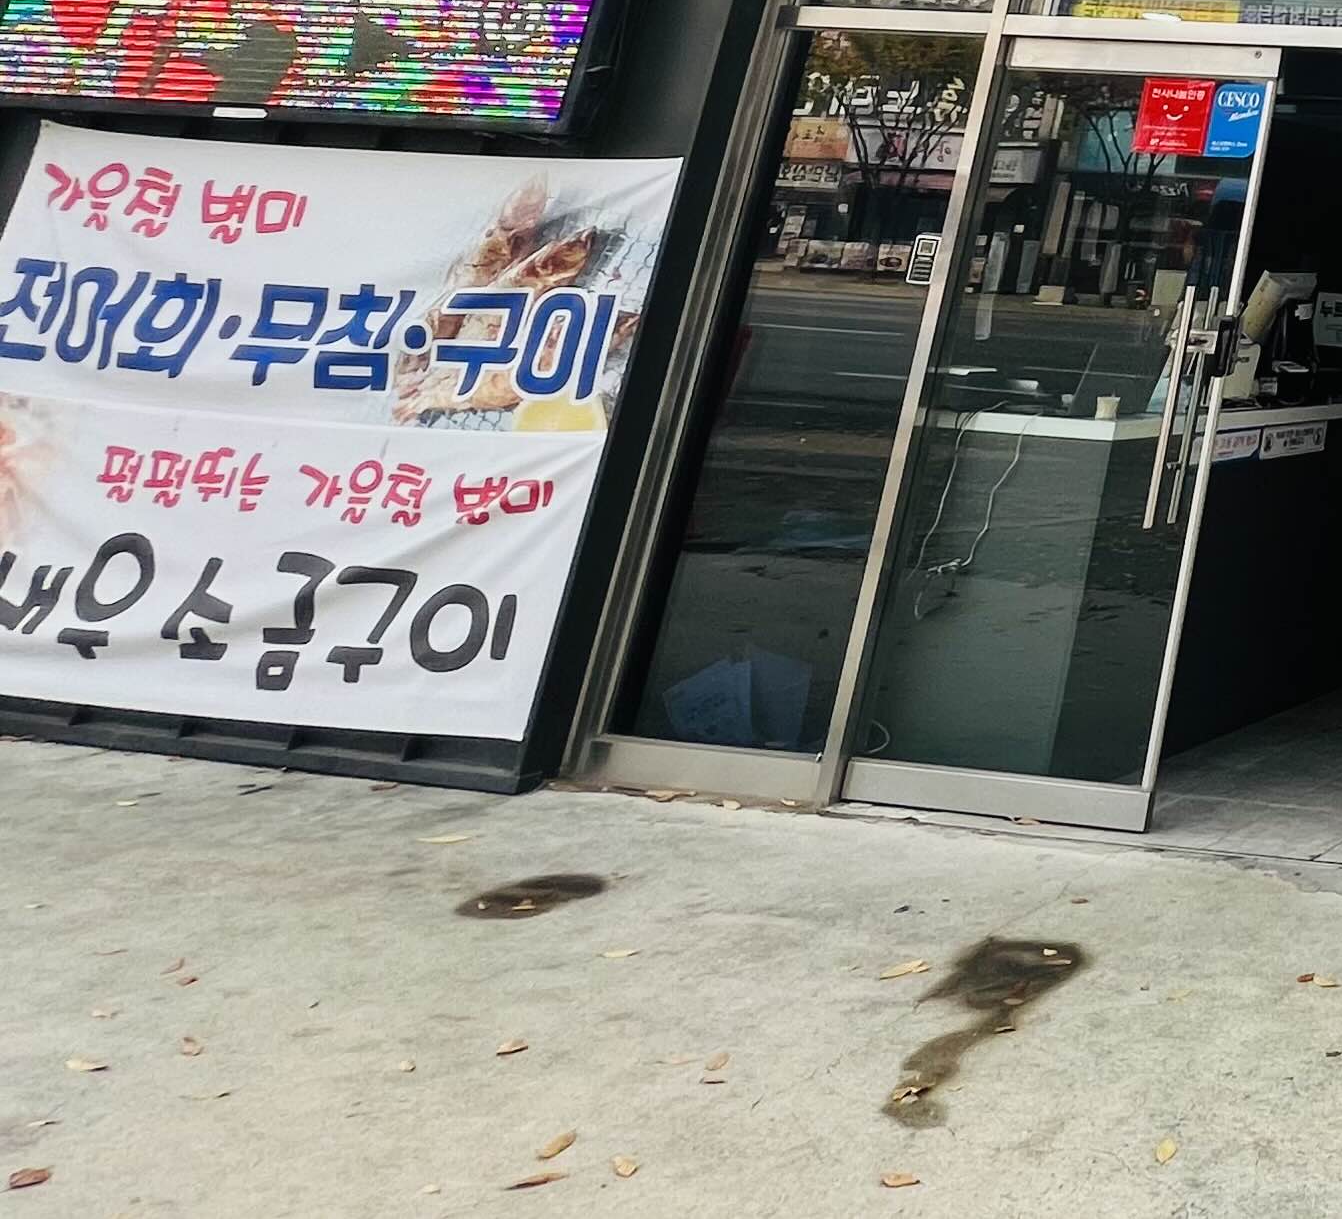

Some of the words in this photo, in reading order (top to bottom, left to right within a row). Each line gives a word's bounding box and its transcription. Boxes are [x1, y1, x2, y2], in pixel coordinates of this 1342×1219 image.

[1217, 90, 1260, 108] CESCO
[44, 162, 183, 238] 가을철
[200, 180, 309, 246] 별미
[96, 444, 272, 514] 펄펄뛰는
[298, 456, 433, 528] 가을철
[452, 472, 555, 527] 별미
